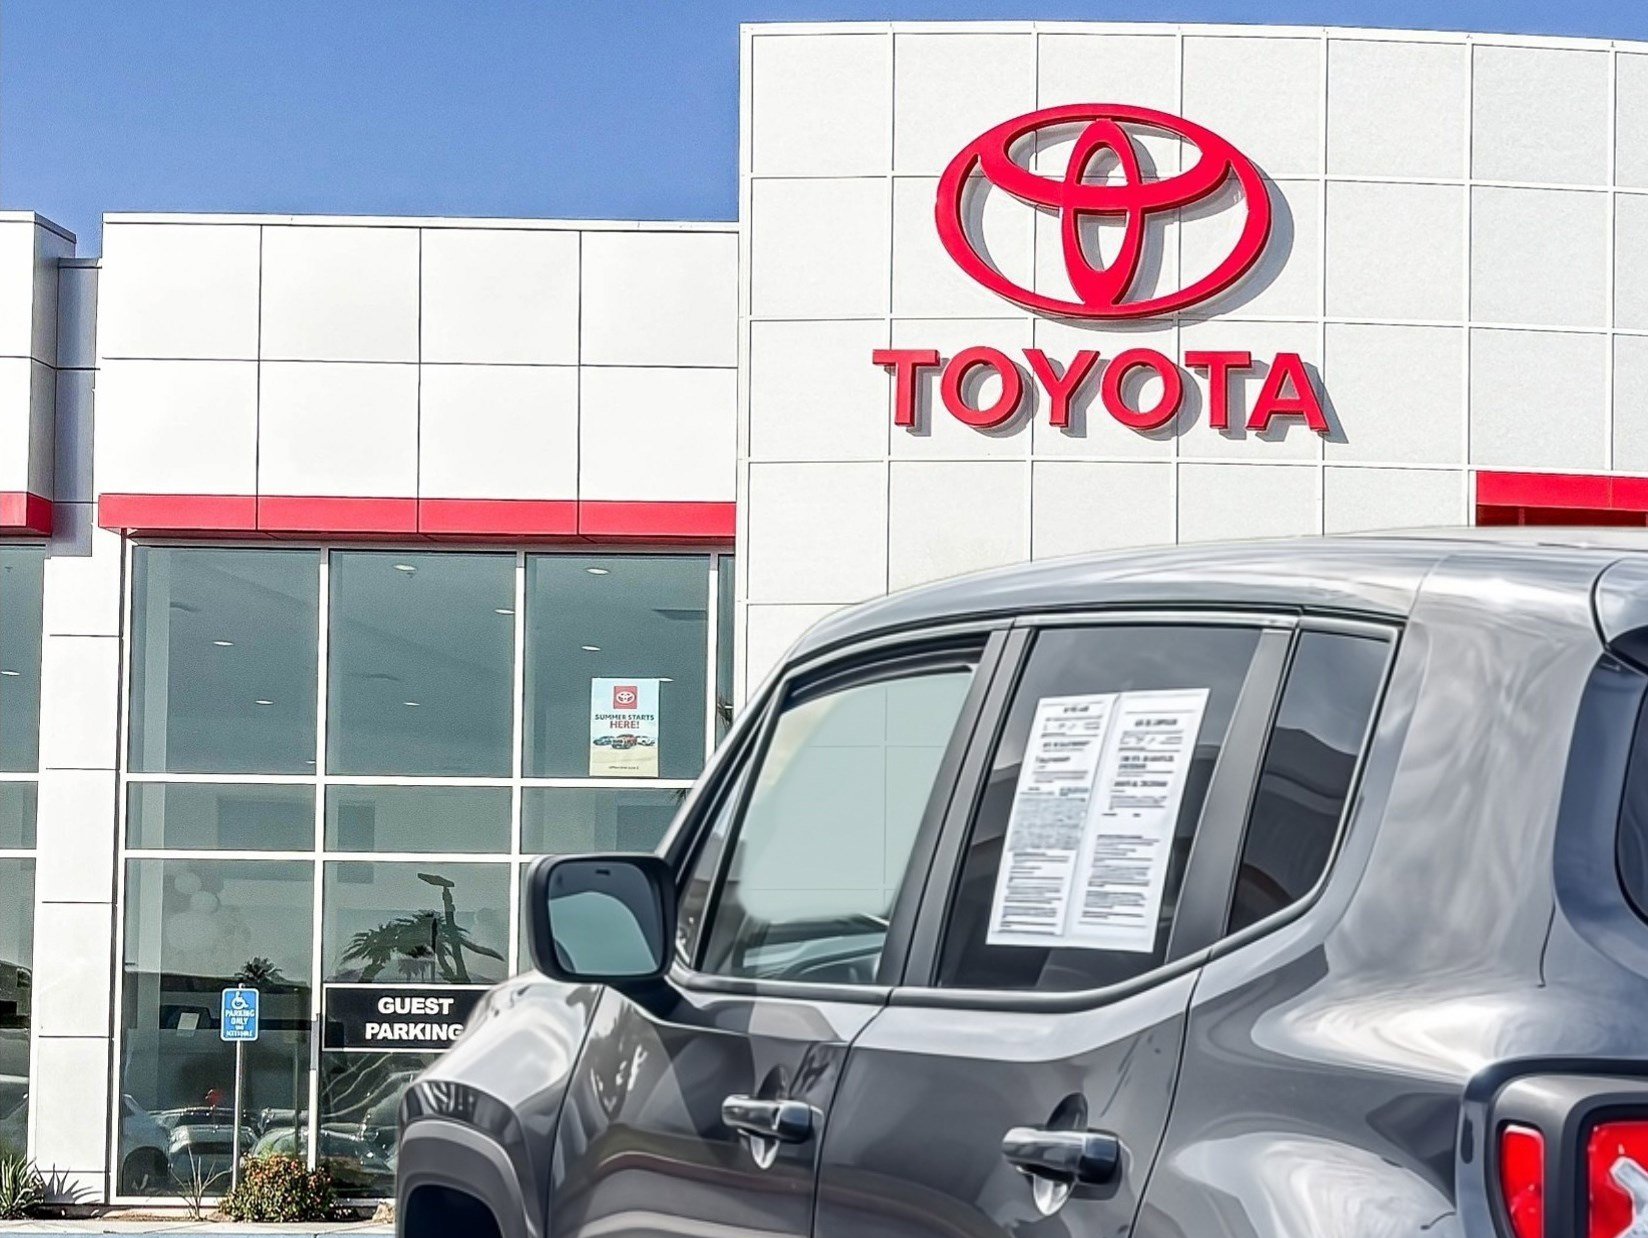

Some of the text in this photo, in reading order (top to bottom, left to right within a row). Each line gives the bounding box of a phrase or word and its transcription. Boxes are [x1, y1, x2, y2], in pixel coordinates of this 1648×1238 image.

[873, 346, 1330, 432] TOYOTA
[609, 720, 640, 729] HERE!
[377, 997, 454, 1015] GUEST
[225, 1009, 256, 1018] PARKING
[230, 1017, 249, 1025] ONLY
[365, 1022, 464, 1041] PARKING
